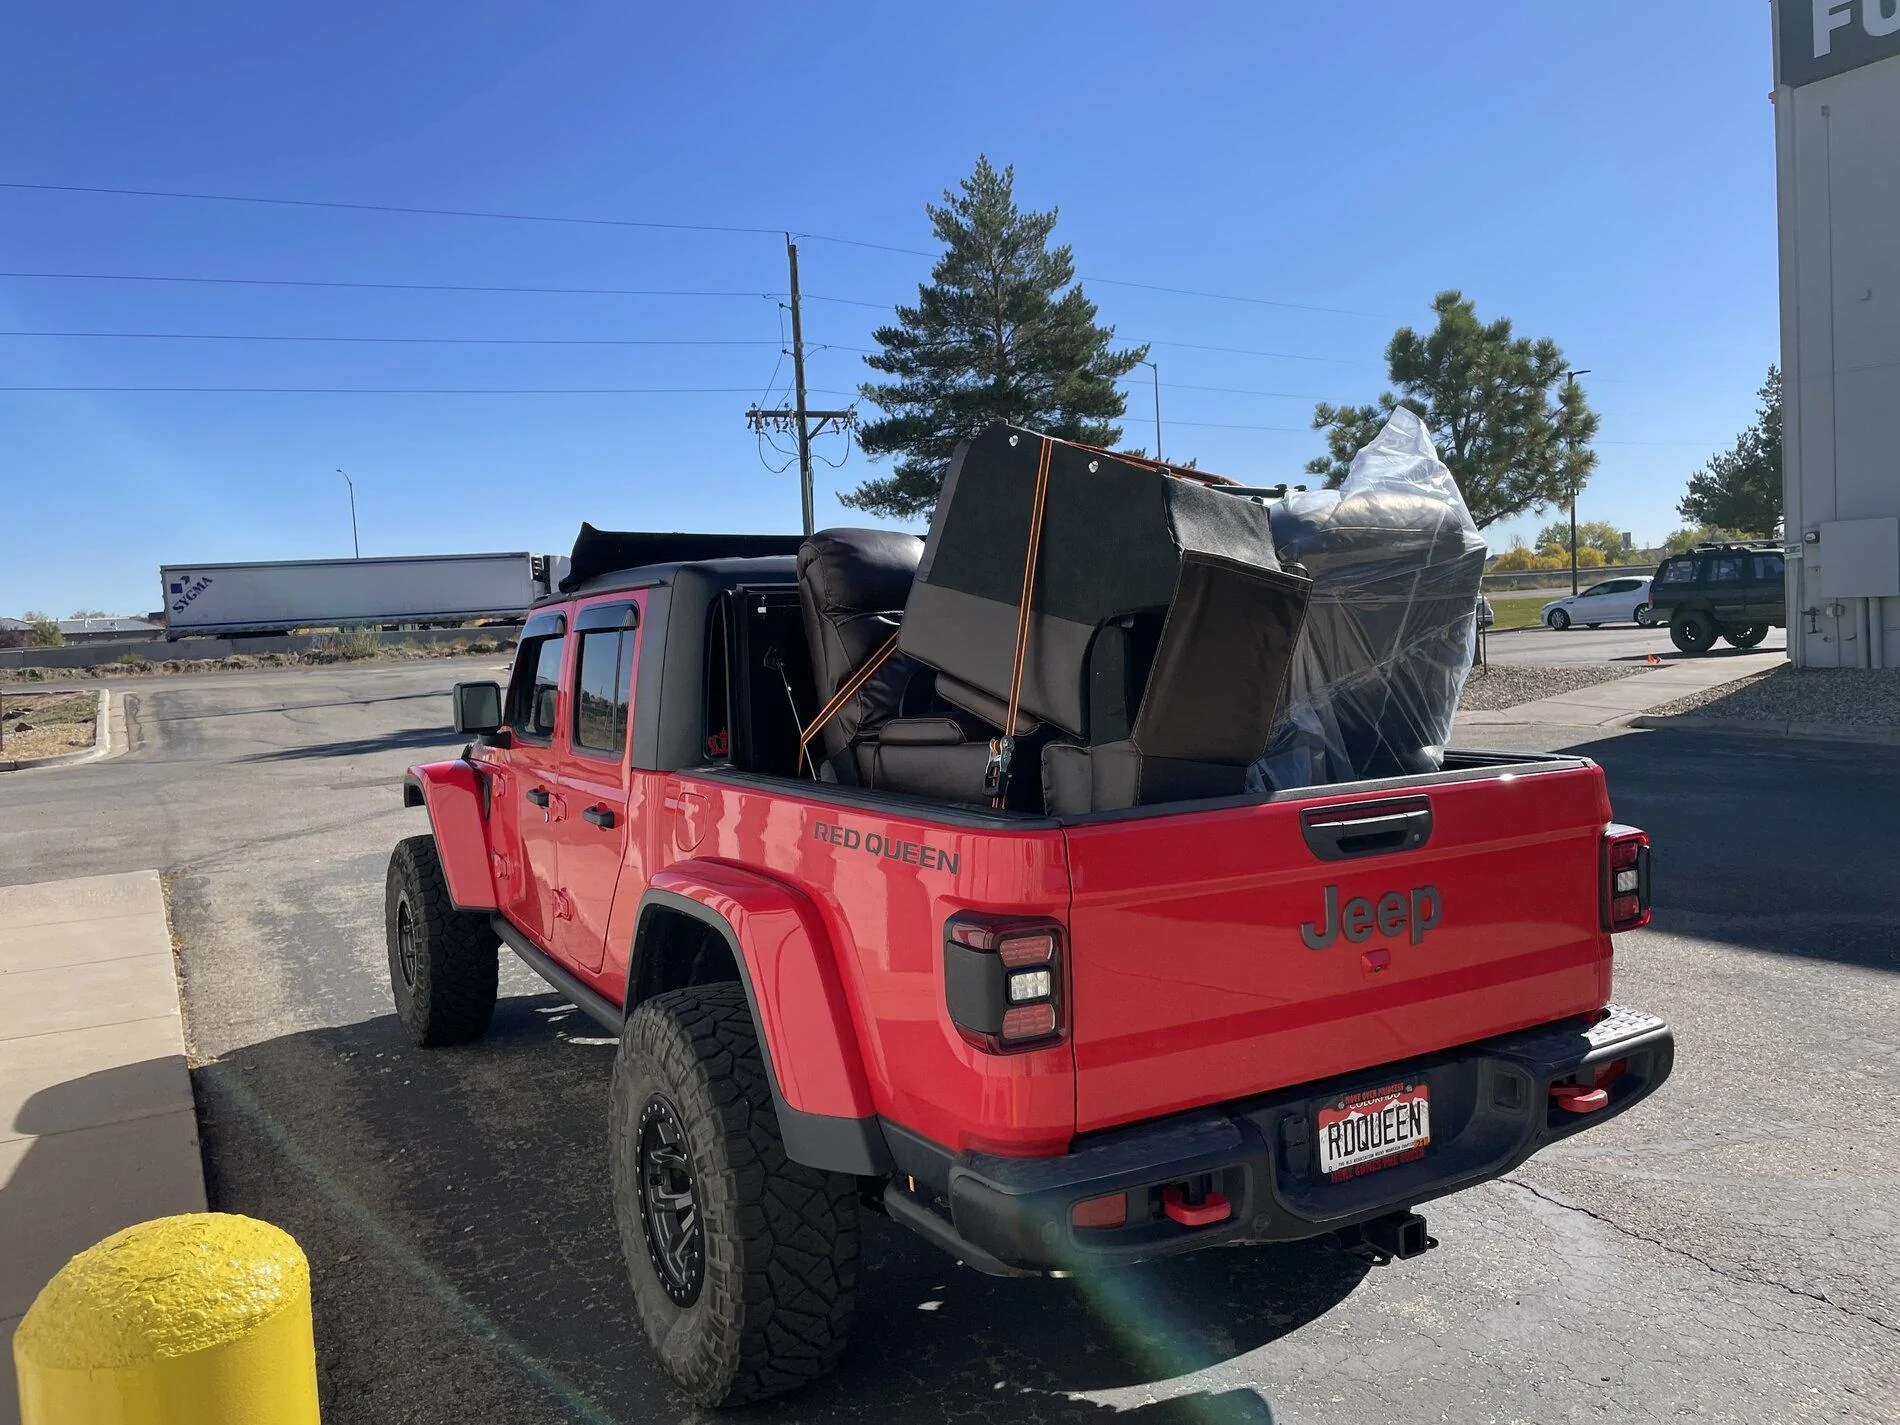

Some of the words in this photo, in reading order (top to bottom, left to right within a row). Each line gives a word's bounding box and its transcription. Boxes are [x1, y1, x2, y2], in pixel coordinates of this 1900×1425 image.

[172, 577, 213, 613] SYGMA
[814, 822, 860, 850] RED
[865, 832, 960, 875] QUEEN
[1300, 884, 1442, 950] Jeep
[1328, 1101, 1422, 1161] RDQUEEN
